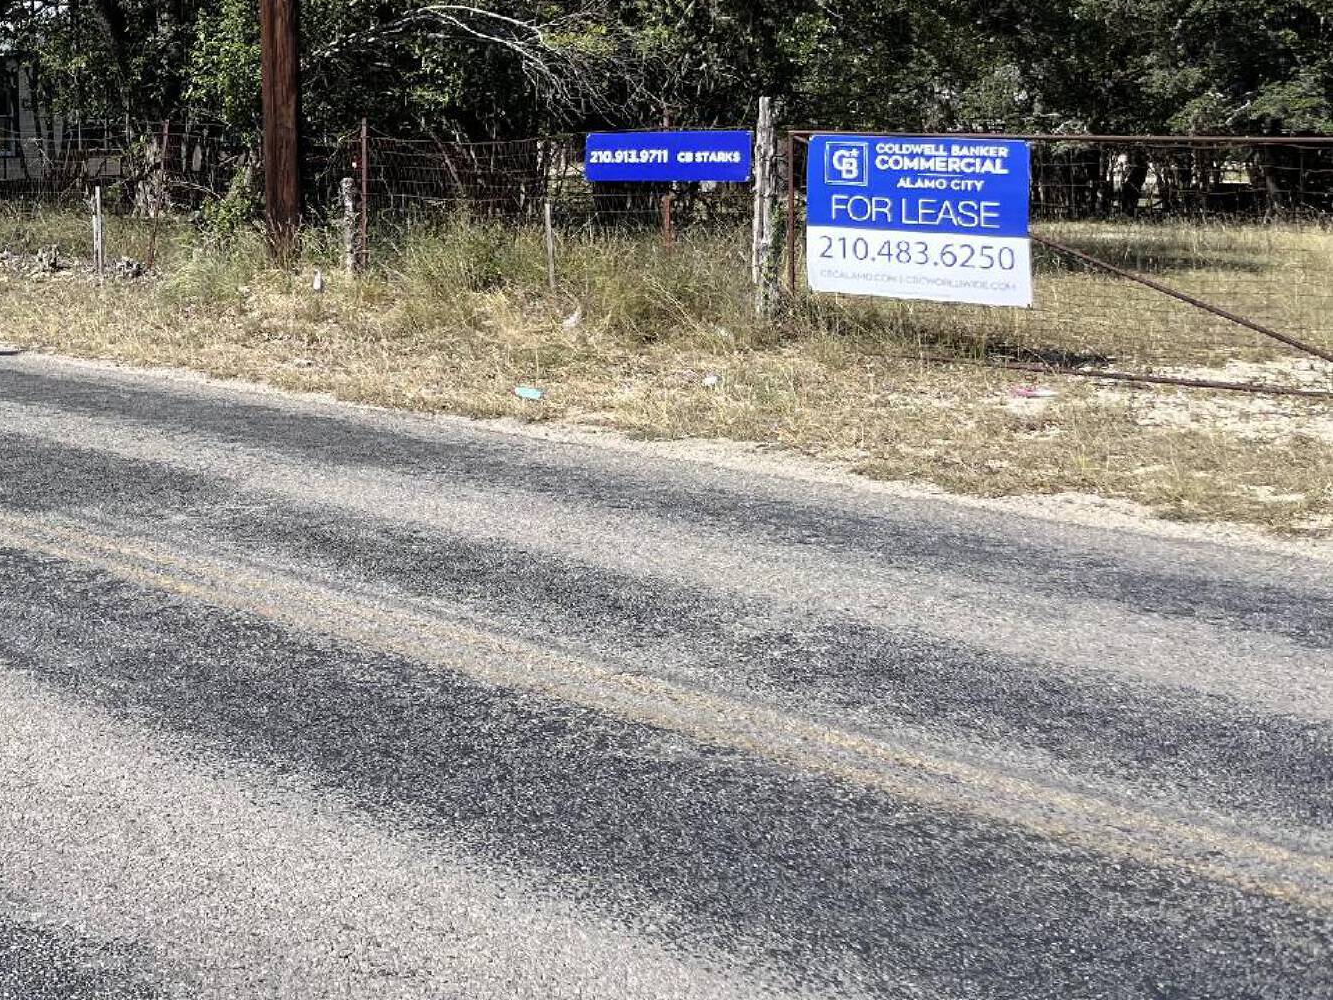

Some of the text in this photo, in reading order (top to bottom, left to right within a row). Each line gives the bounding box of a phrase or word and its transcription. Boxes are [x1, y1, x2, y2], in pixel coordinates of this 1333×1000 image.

[589, 149, 741, 164] 210.913.9711 CB STARKS
[875, 143, 1009, 158] COLDWELL BANKER
[875, 155, 1010, 174] COMMERCIAL
[896, 178, 985, 191] ALAMO CITY
[831, 194, 1000, 228] FOR LEASE
[819, 235, 1015, 270] 210.483.6250
